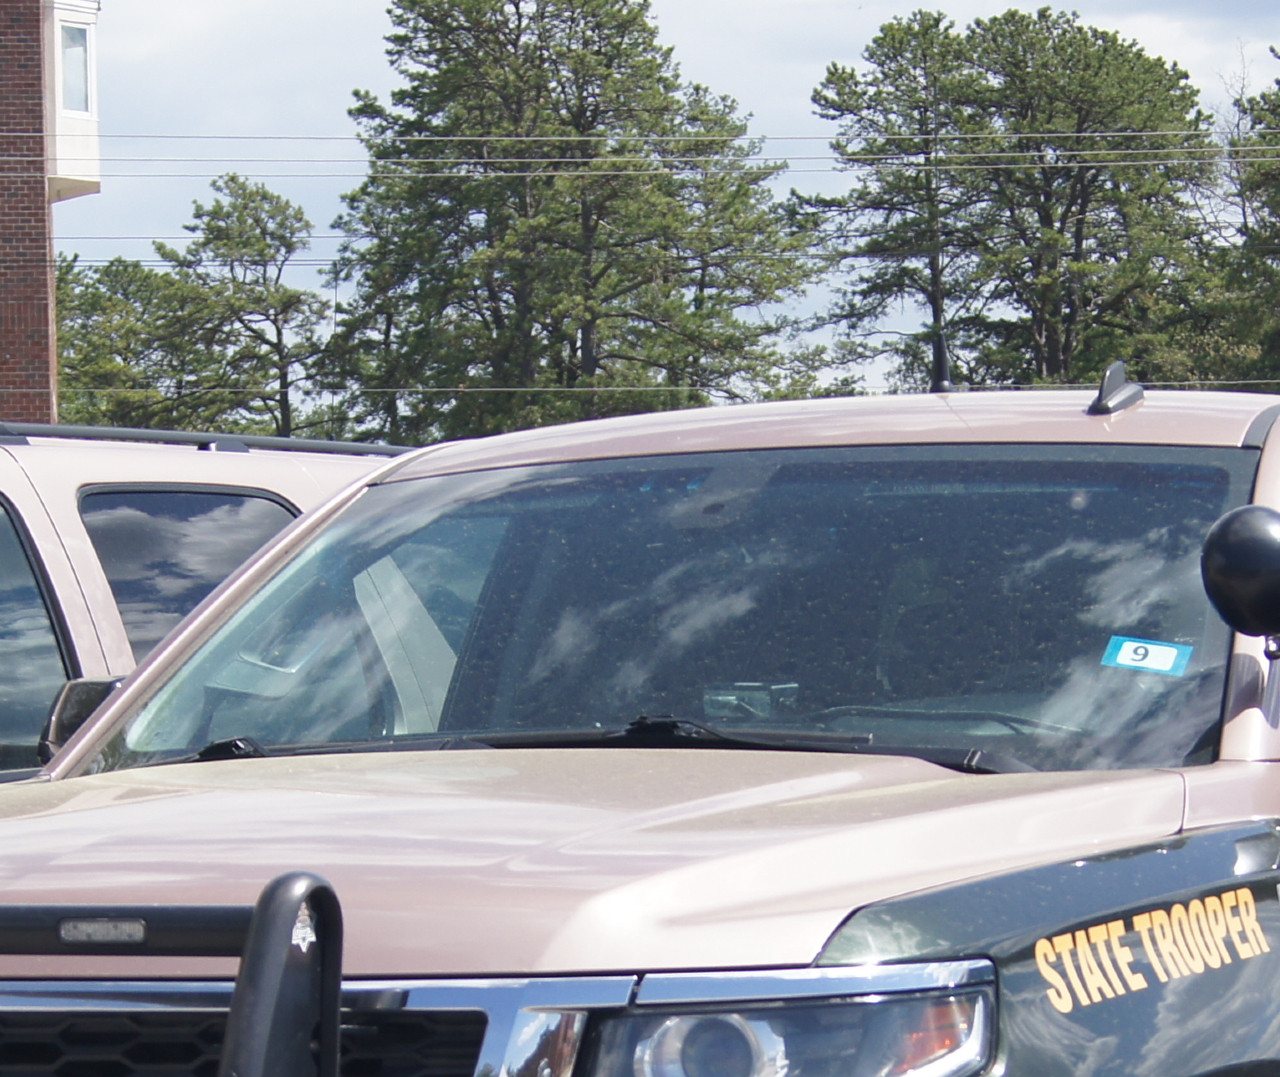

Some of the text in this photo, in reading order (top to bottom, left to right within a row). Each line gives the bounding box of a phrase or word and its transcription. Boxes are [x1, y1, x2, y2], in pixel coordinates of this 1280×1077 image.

[1130, 645, 1150, 662] 9
[1034, 887, 1270, 1014] STATE TROOPER
